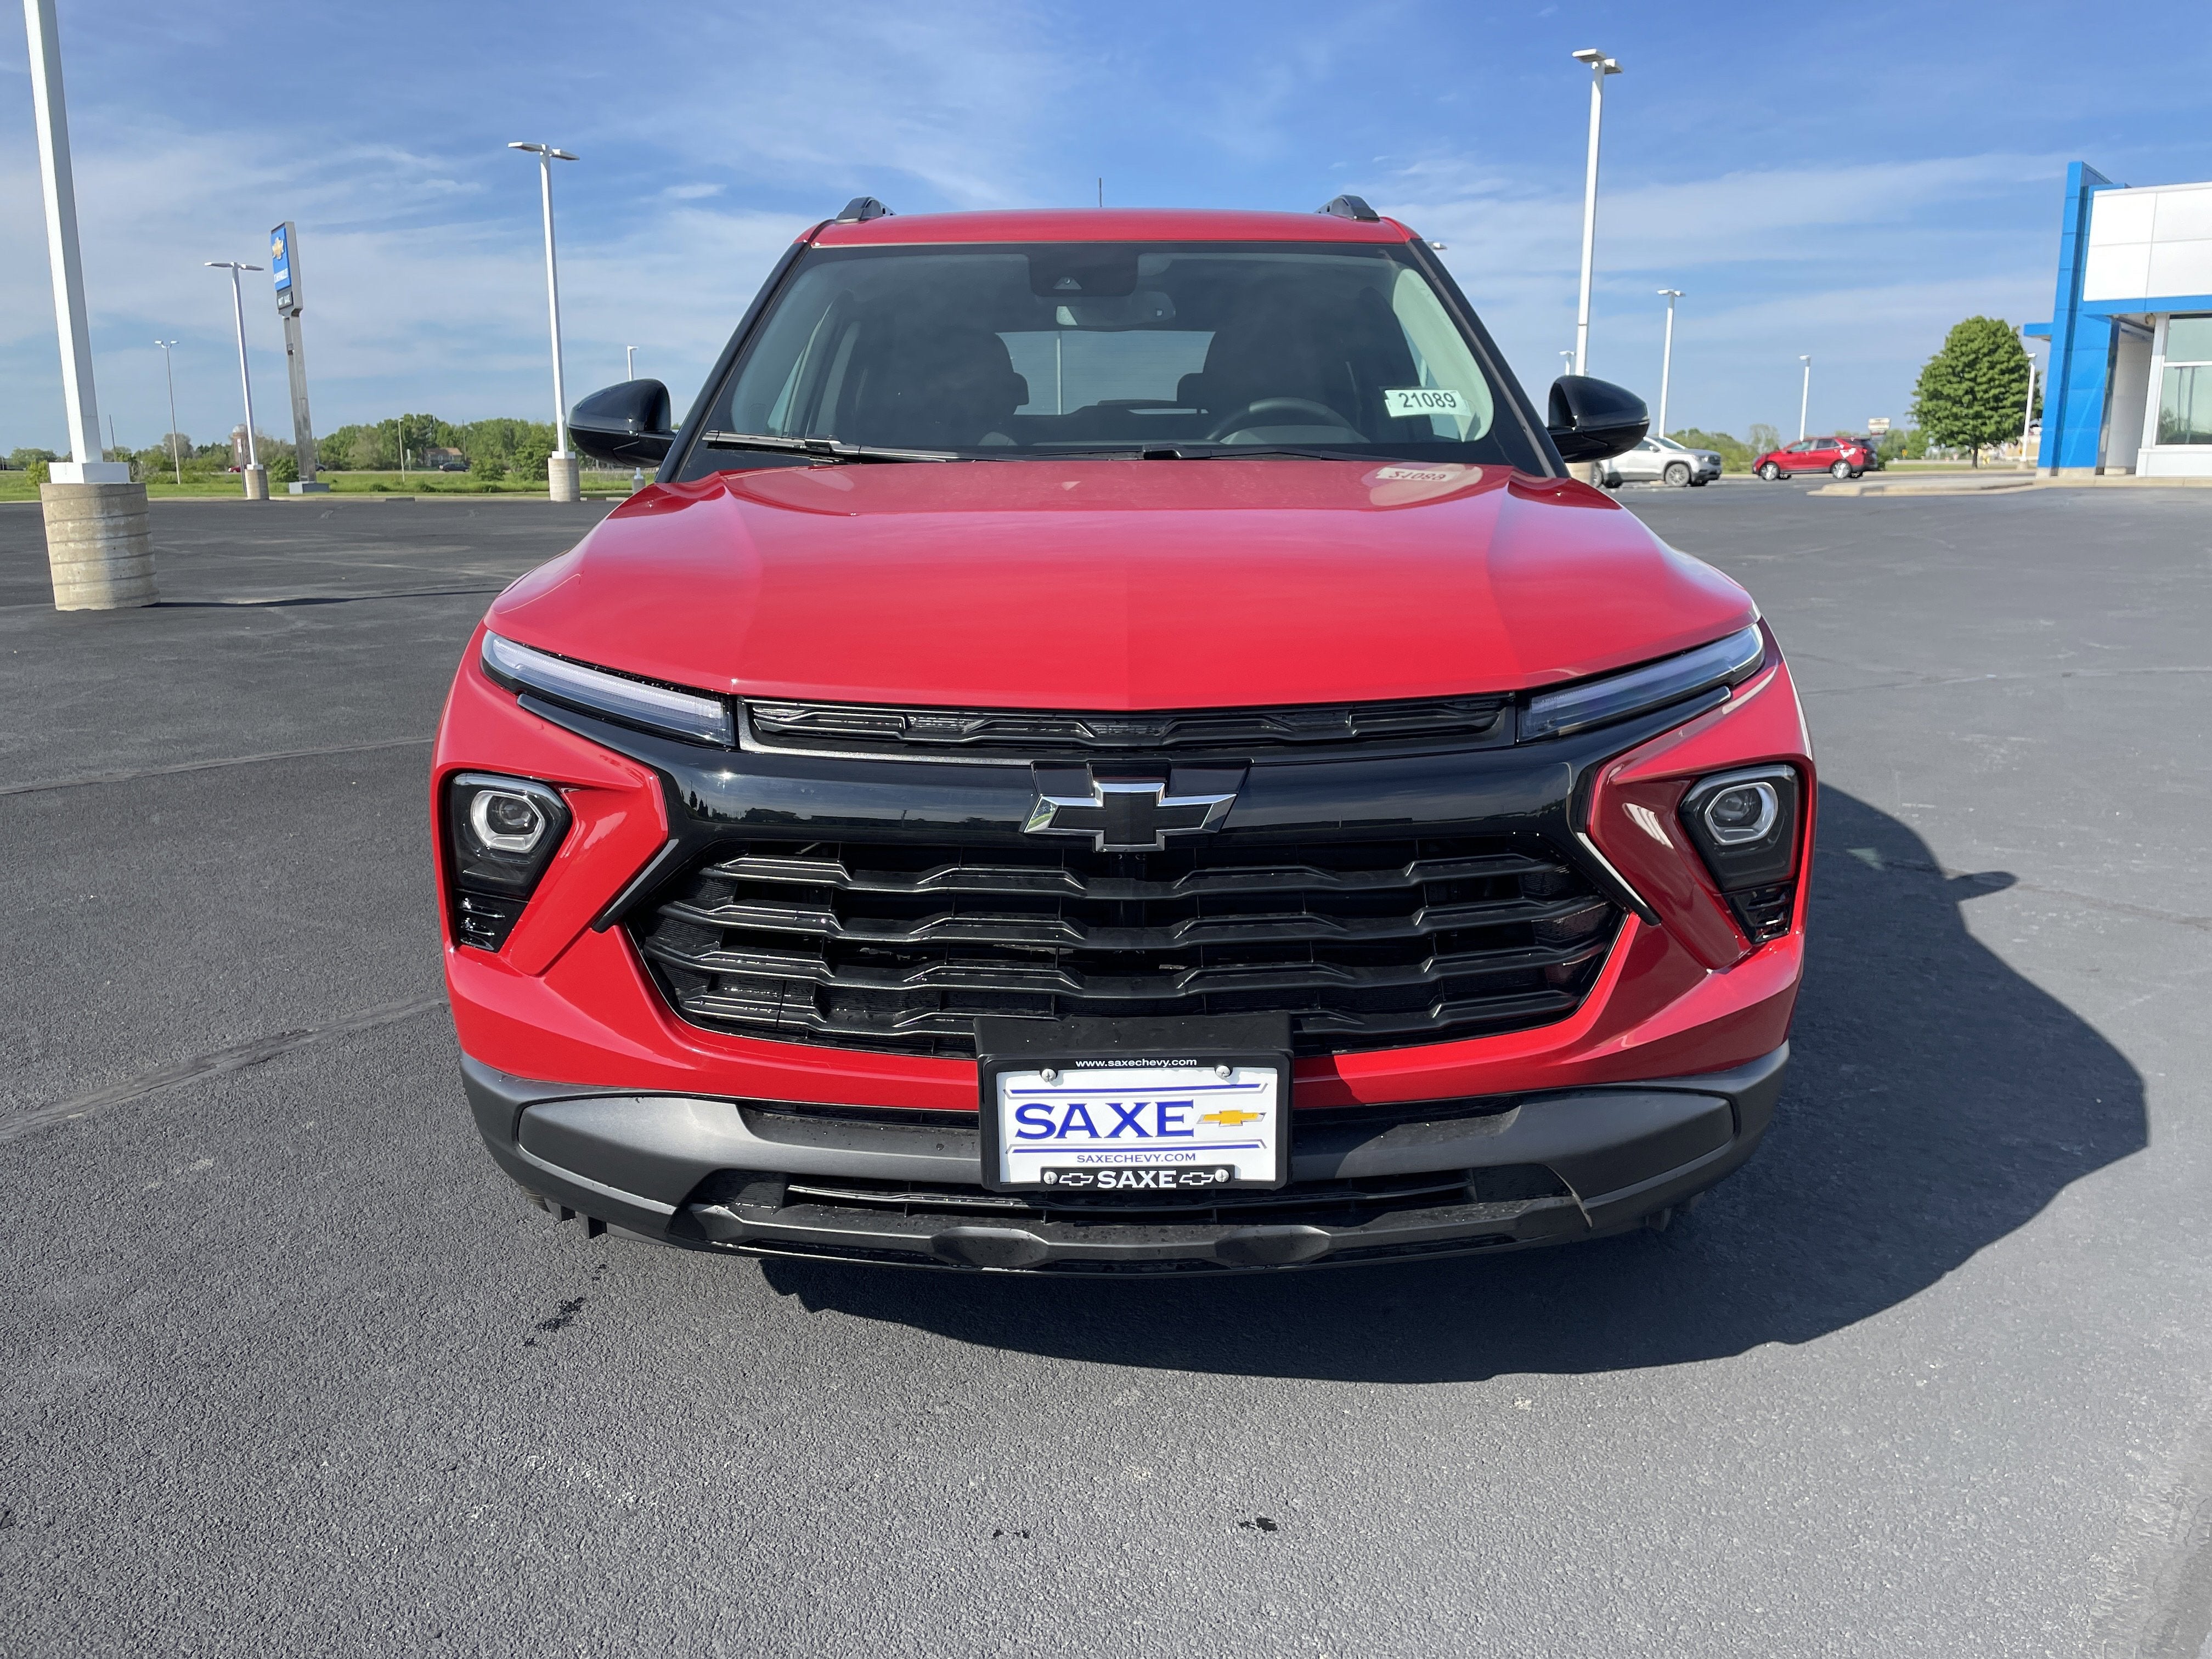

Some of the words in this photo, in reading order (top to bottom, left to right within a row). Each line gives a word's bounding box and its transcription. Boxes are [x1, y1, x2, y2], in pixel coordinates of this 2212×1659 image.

[1398, 392, 1457, 408] 21089
[1075, 1058, 1197, 1068] www.saxechevy.com
[1015, 1099, 1194, 1139] SAXE
[1076, 1153, 1196, 1163] SAXECHEVY.COM
[1097, 1170, 1177, 1189] SAXE
